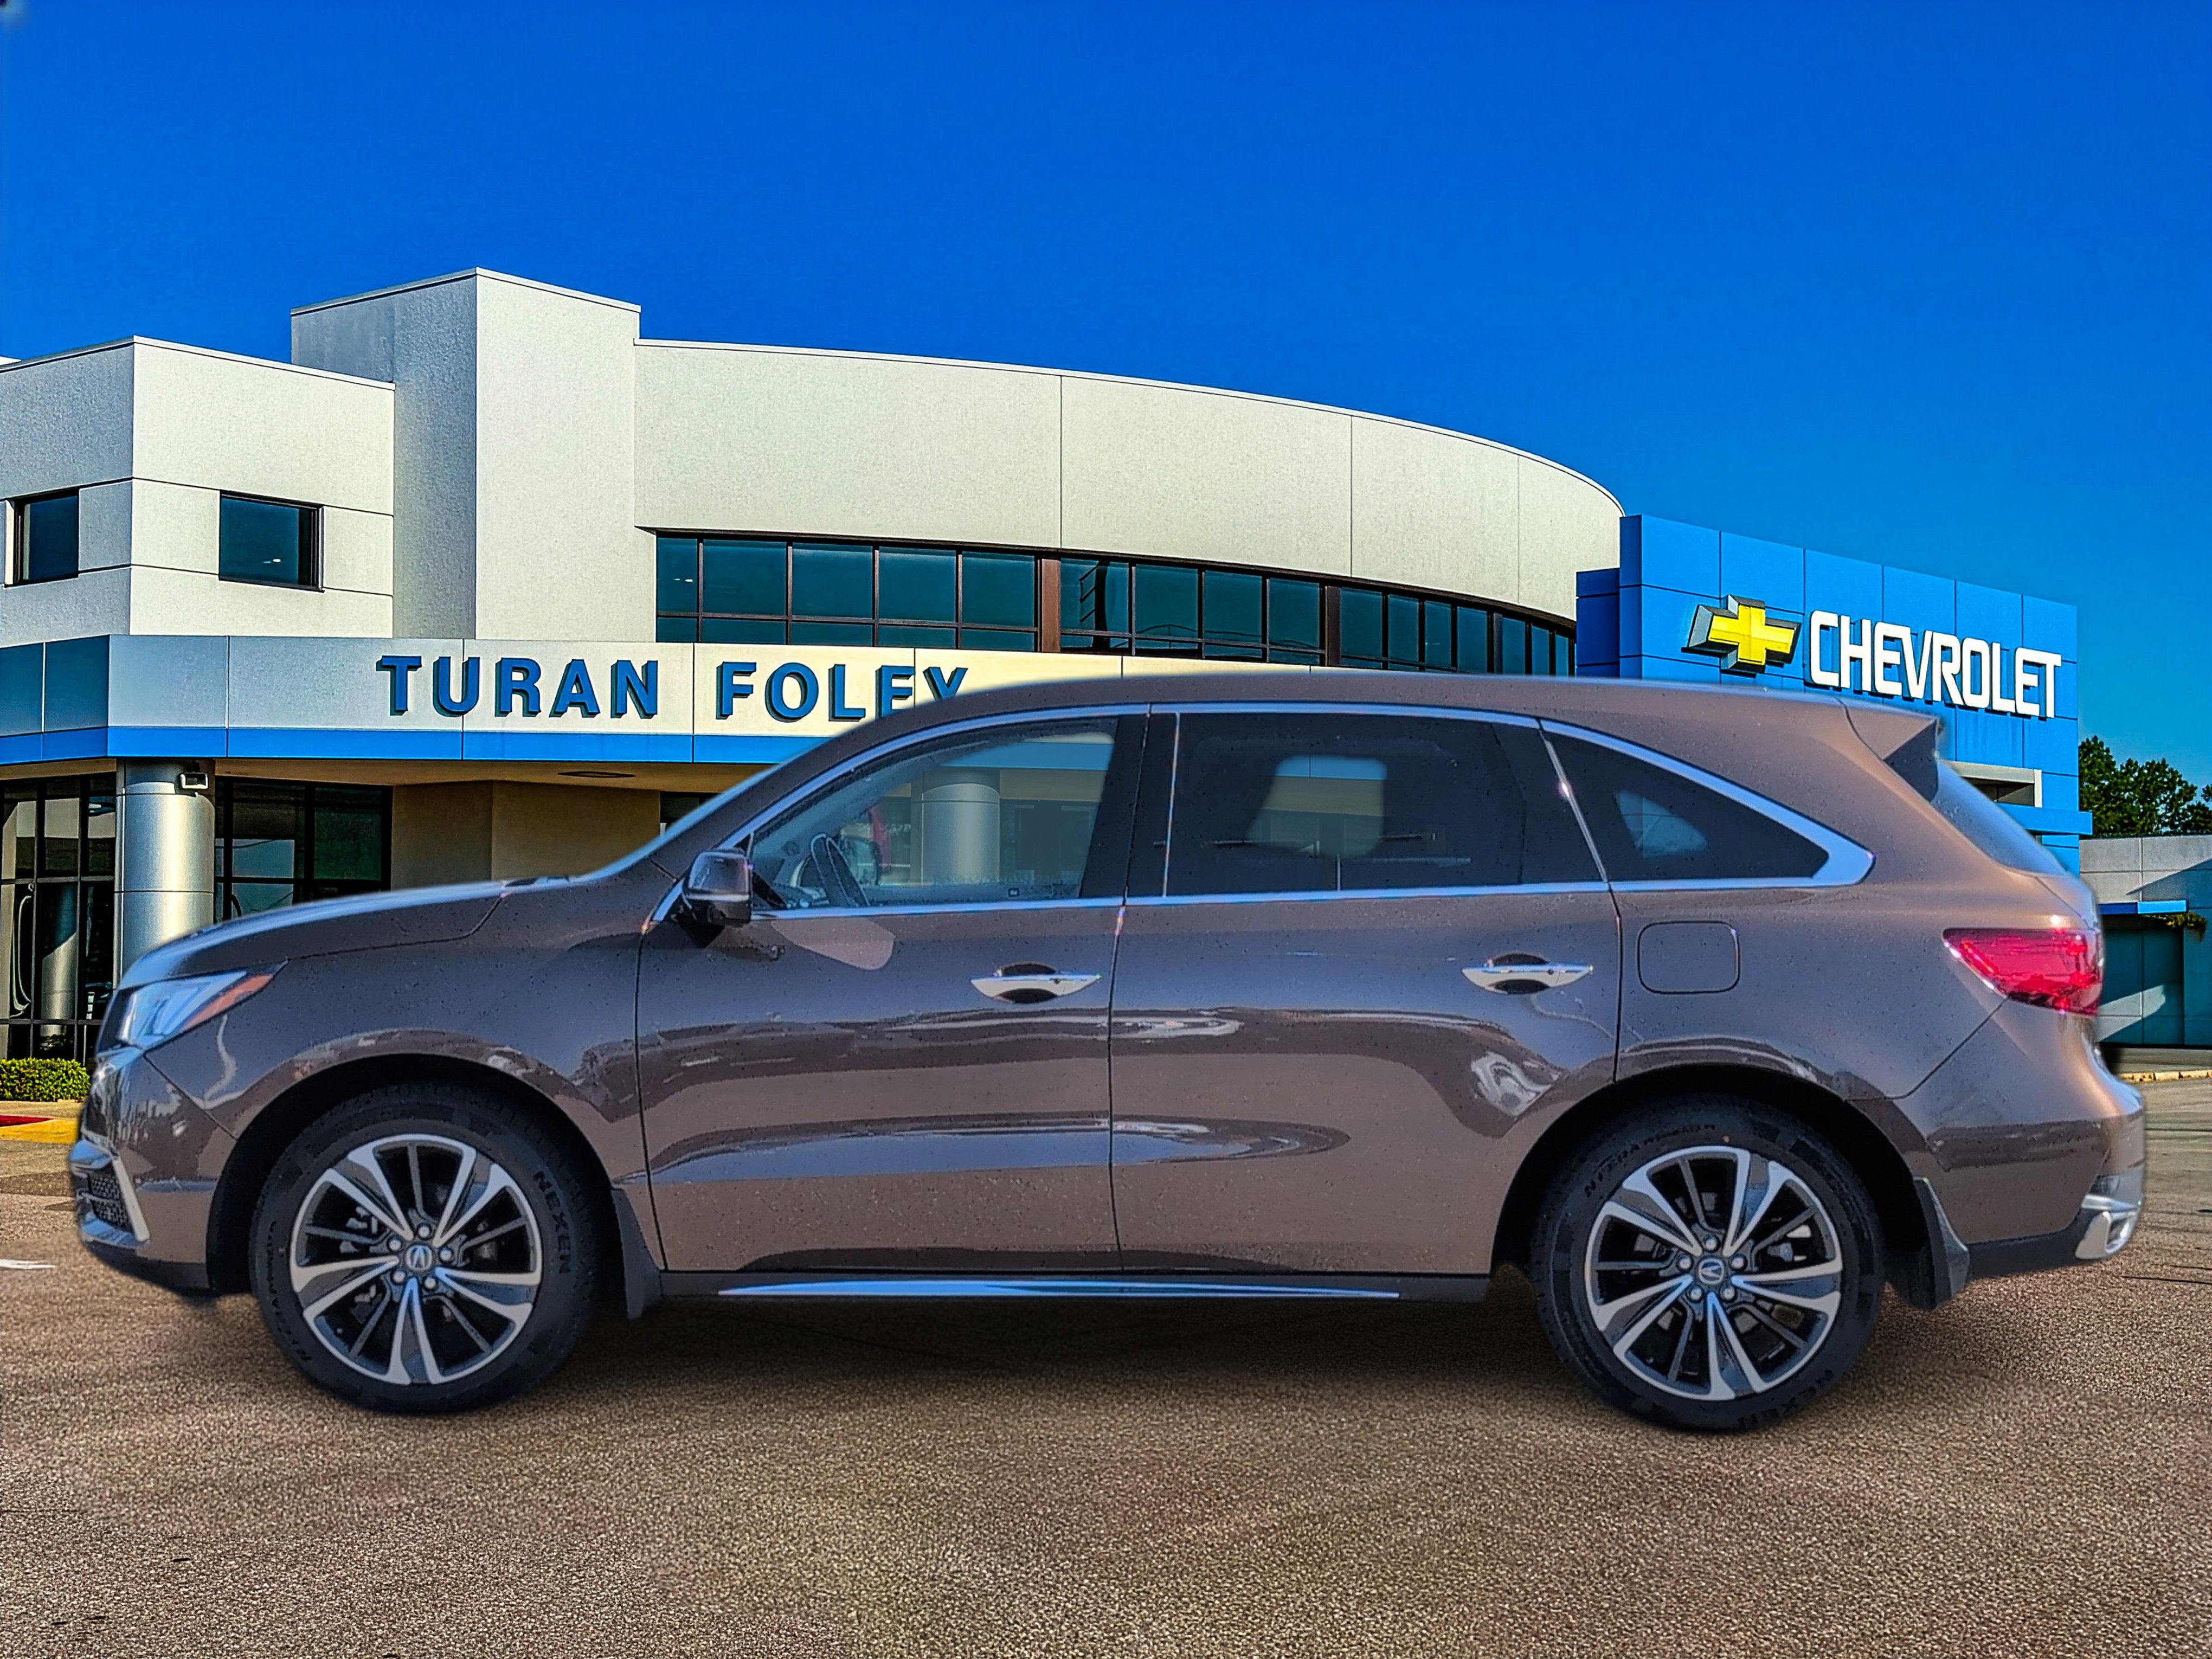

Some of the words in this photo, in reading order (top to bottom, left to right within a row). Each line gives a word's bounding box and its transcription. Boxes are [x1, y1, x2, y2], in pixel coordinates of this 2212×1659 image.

[376, 655, 658, 719] TURAN
[716, 661, 969, 722] FOLEY
[1807, 609, 2062, 718] CHEVROLET
[532, 1169, 571, 1274] NEXEN
